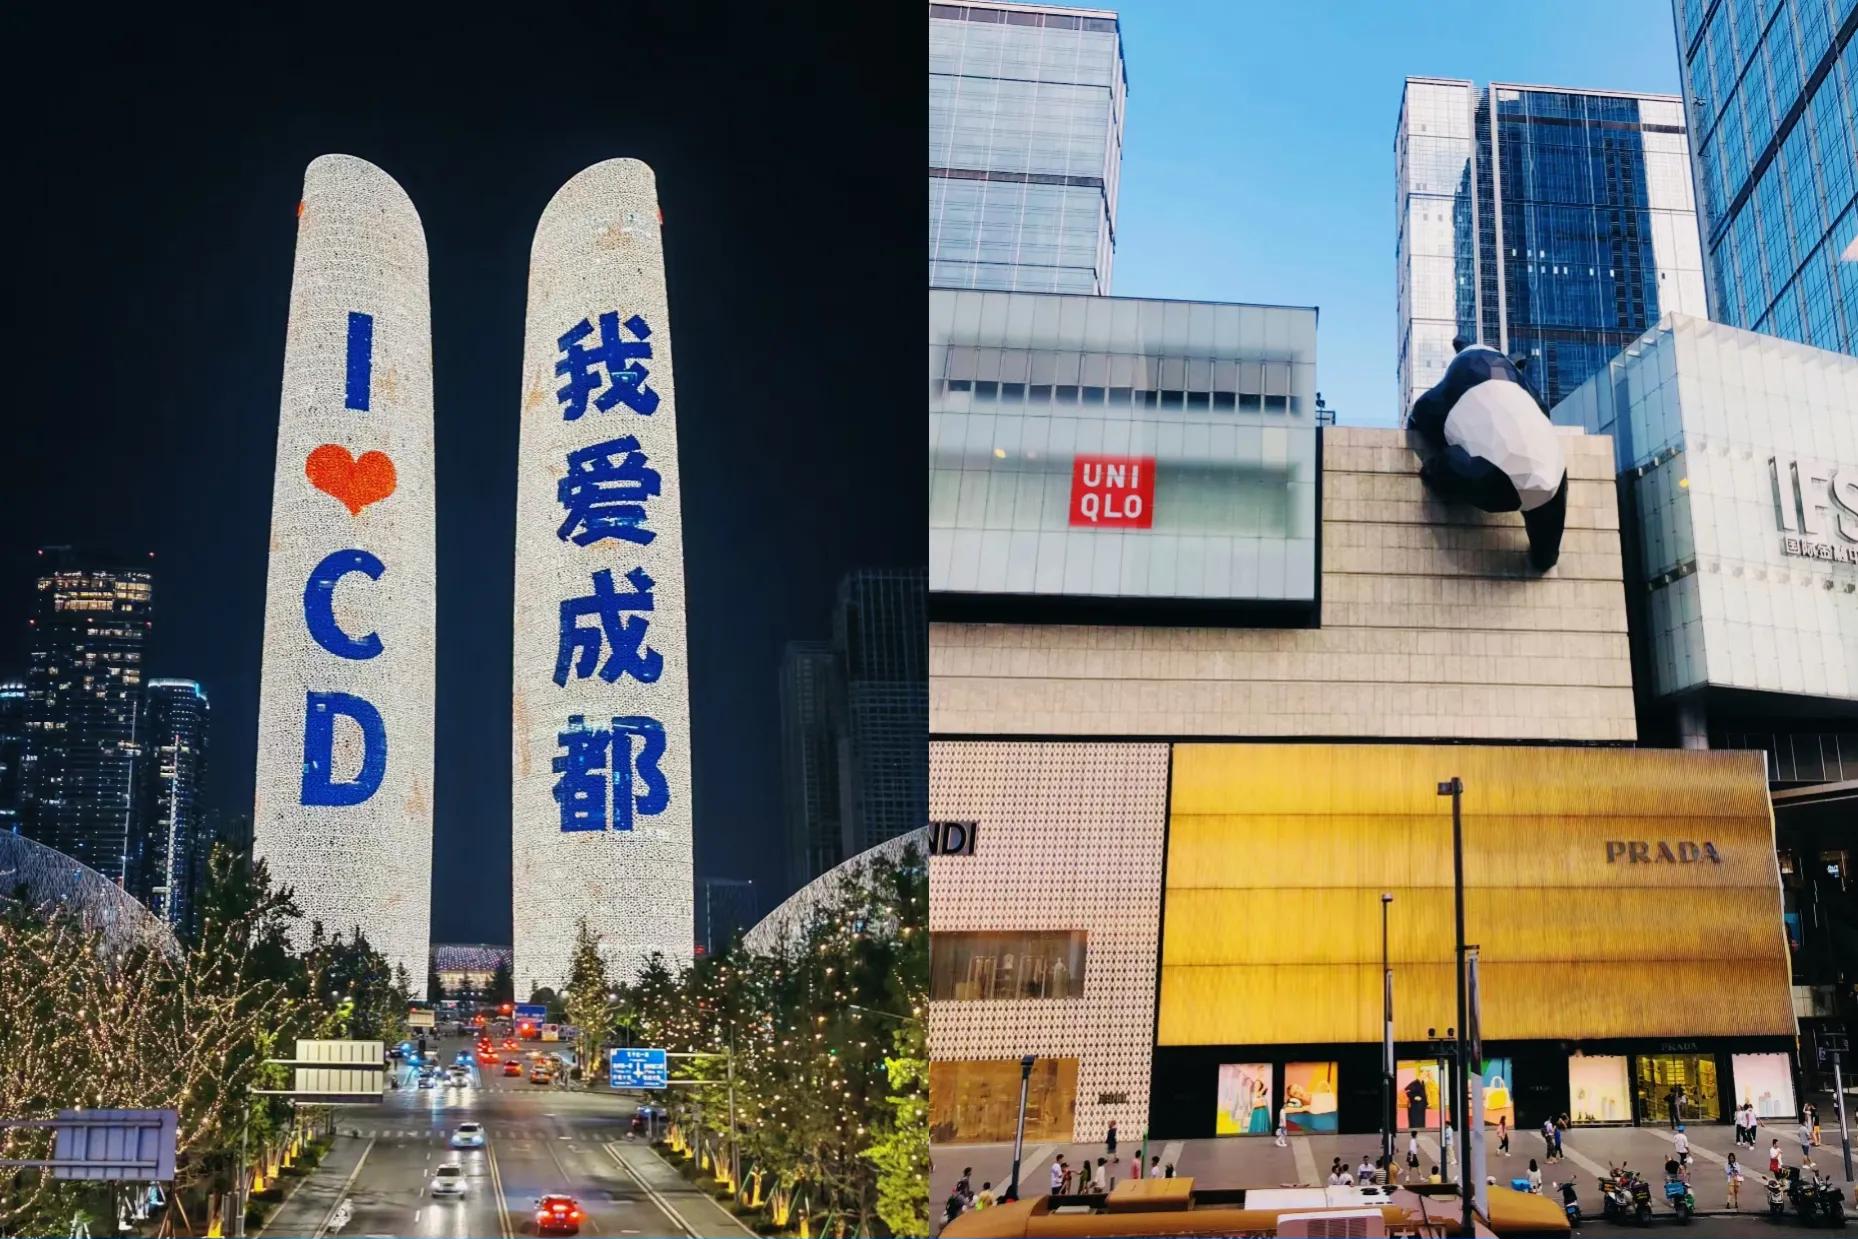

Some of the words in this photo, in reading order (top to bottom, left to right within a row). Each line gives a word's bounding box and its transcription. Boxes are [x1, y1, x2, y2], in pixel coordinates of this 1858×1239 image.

[345, 311, 373, 412] I
[1083, 463, 1139, 489] UNI
[1081, 492, 1143, 523] QLO
[552, 310, 670, 833] 我爱成都
[1605, 840, 1721, 864] PRADA
